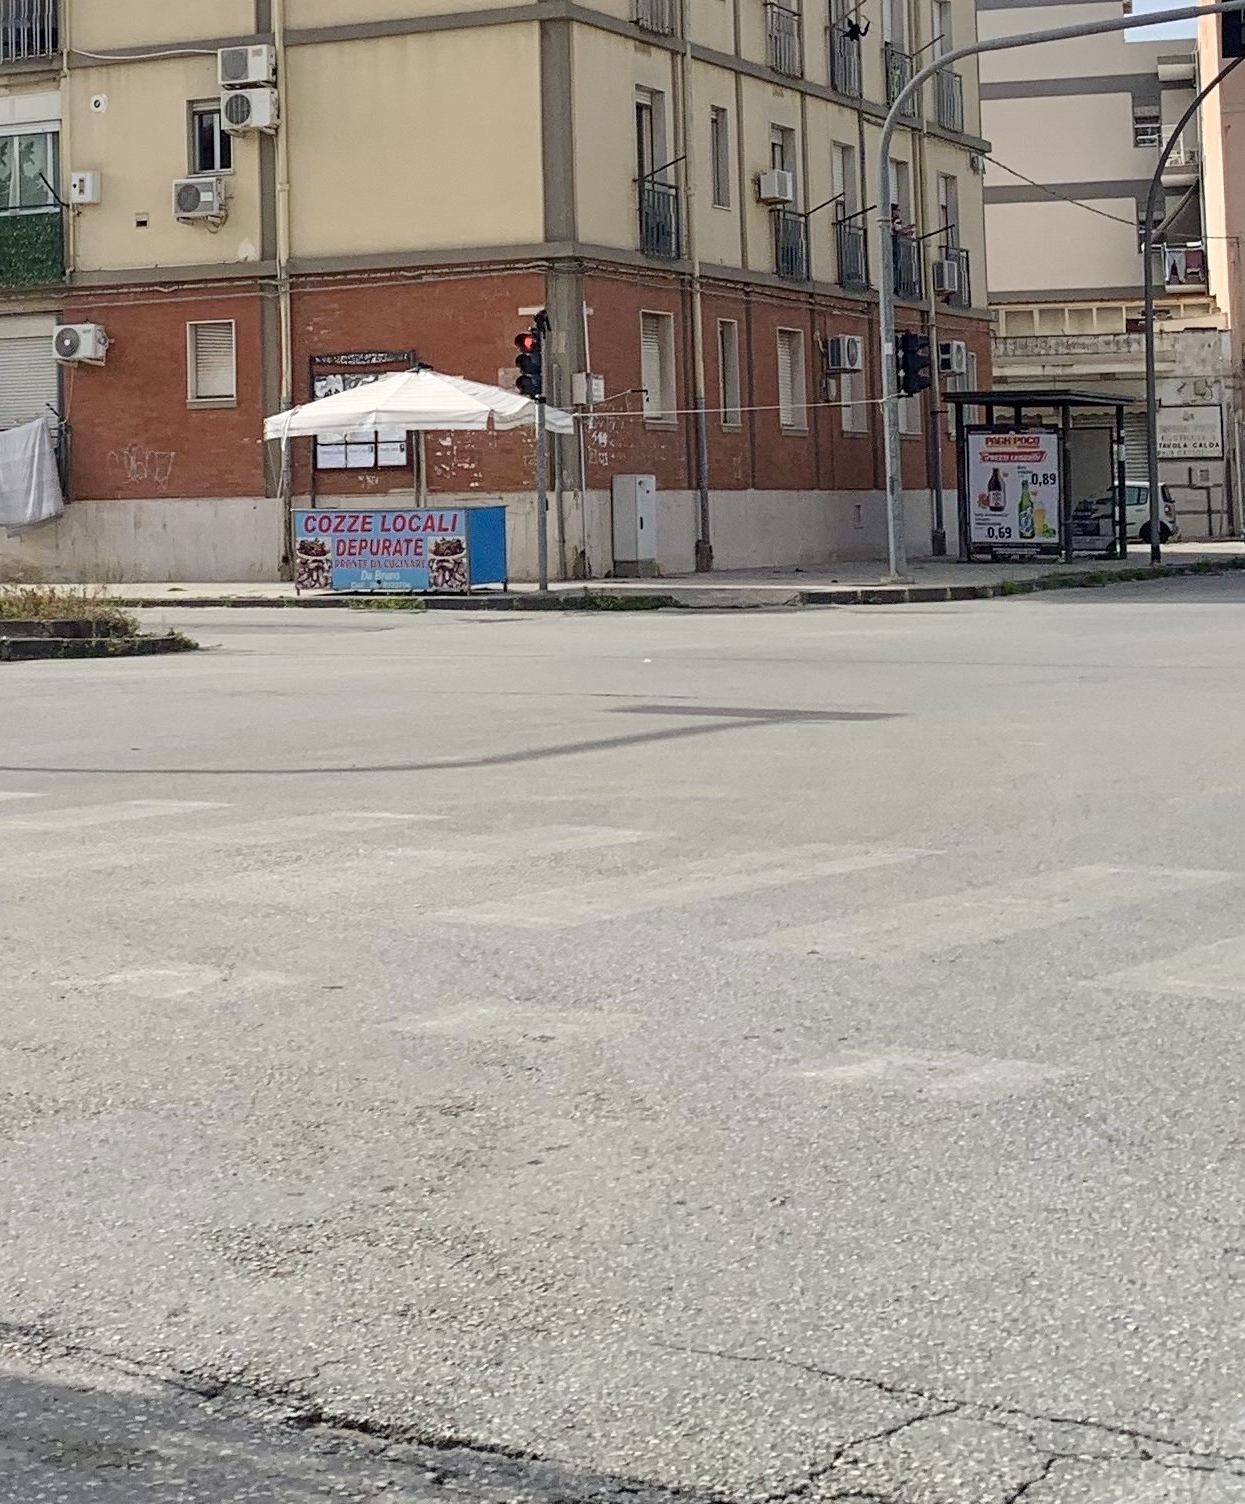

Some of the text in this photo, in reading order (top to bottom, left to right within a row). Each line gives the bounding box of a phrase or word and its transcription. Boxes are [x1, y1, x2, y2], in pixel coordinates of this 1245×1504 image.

[1031, 473, 1056, 486] 0,89
[304, 513, 458, 533] COZZE LOCALI
[987, 526, 1011, 540] 0,69
[336, 538, 424, 556] DEPURATE
[375, 570, 401, 580] Bruno
